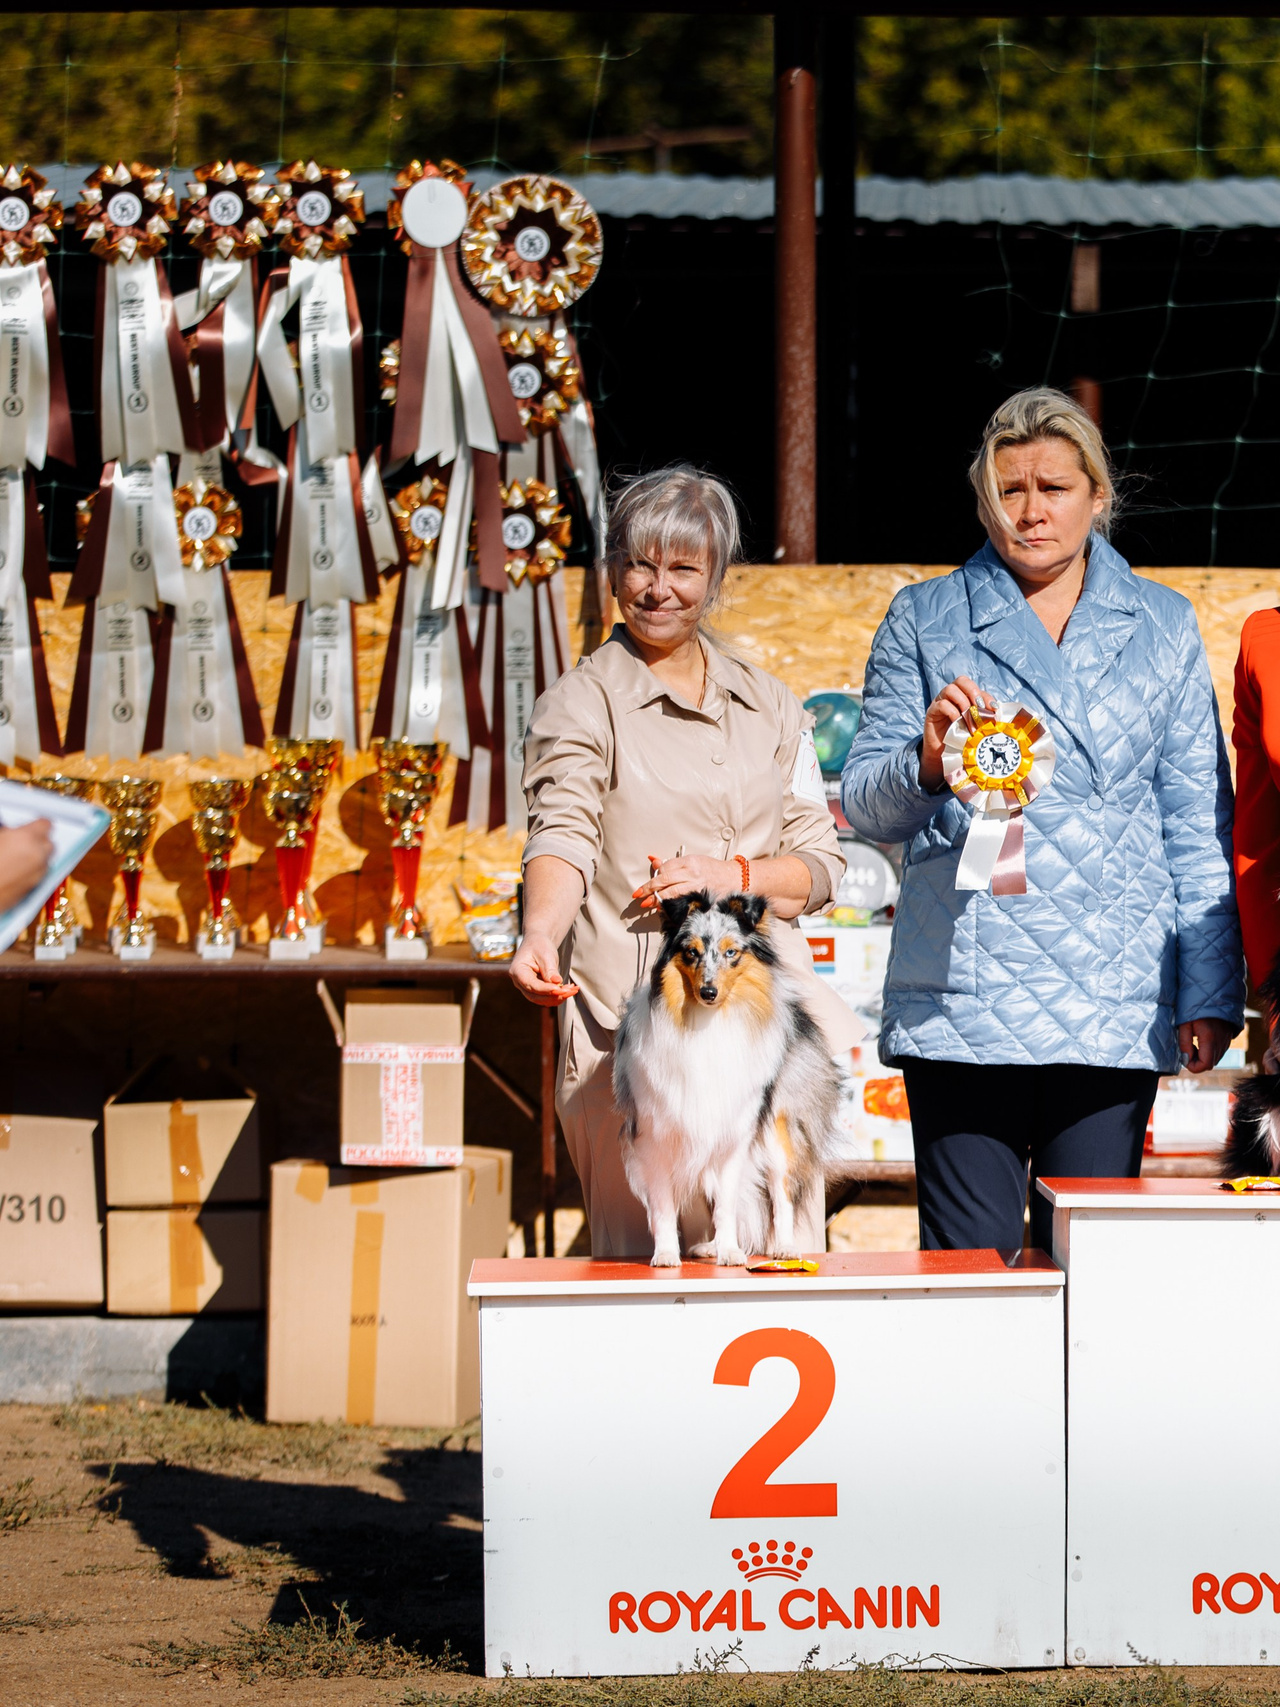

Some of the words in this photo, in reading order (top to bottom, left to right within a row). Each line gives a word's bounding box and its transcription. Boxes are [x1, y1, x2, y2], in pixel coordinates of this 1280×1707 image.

[709, 1327, 838, 1519] 2
[609, 1588, 766, 1633] ROYAL
[778, 1584, 940, 1630] CANIN
